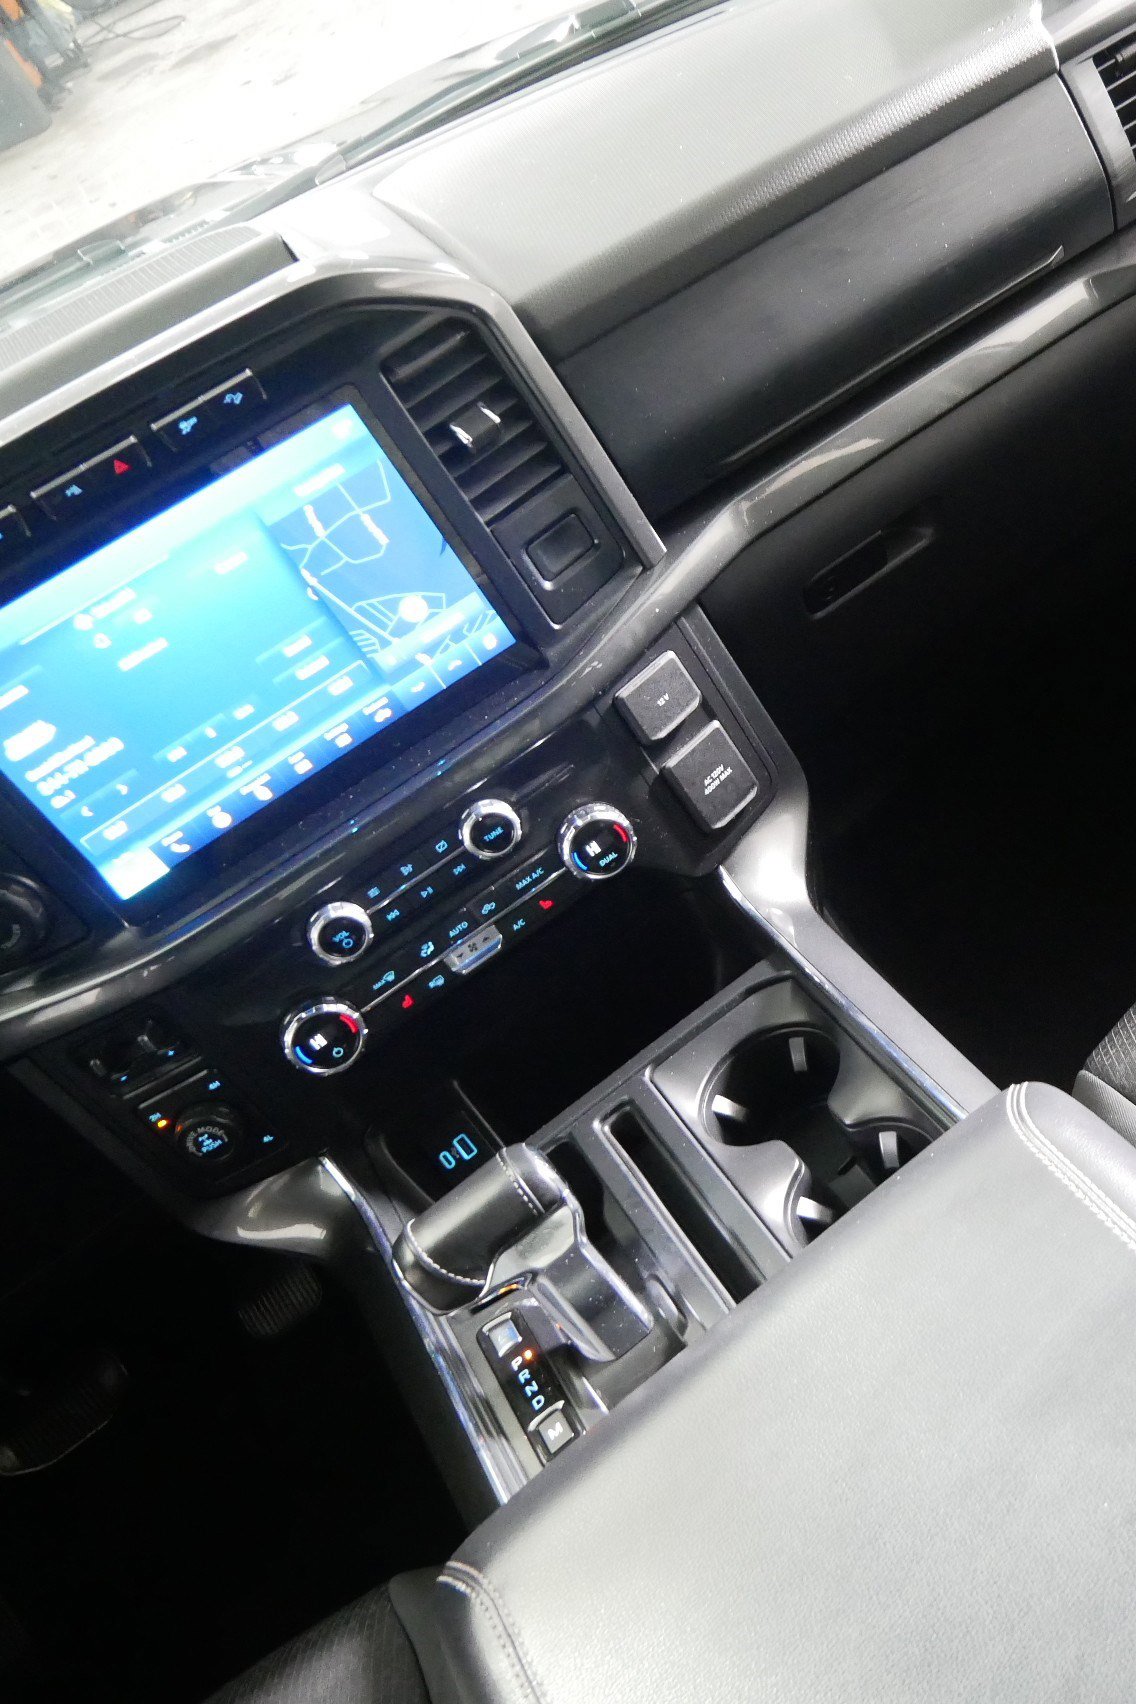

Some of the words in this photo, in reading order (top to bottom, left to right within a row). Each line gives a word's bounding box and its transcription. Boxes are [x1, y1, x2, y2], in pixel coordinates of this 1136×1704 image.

[704, 776, 713, 786] AC
[711, 764, 724, 777] 120V
[720, 767, 733, 781] MAX
[484, 827, 504, 841] TUNE
[599, 852, 618, 867] DUAL
[515, 875, 533, 890] MAX
[531, 866, 545, 880] A/C
[449, 920, 469, 938] AUTO
[513, 918, 526, 931] A/C
[332, 930, 350, 943] VOL
[511, 1356, 522, 1371] P
[519, 1369, 531, 1383] R
[525, 1381, 538, 1396] N
[532, 1395, 544, 1410] D
[548, 1422, 563, 1440] M
